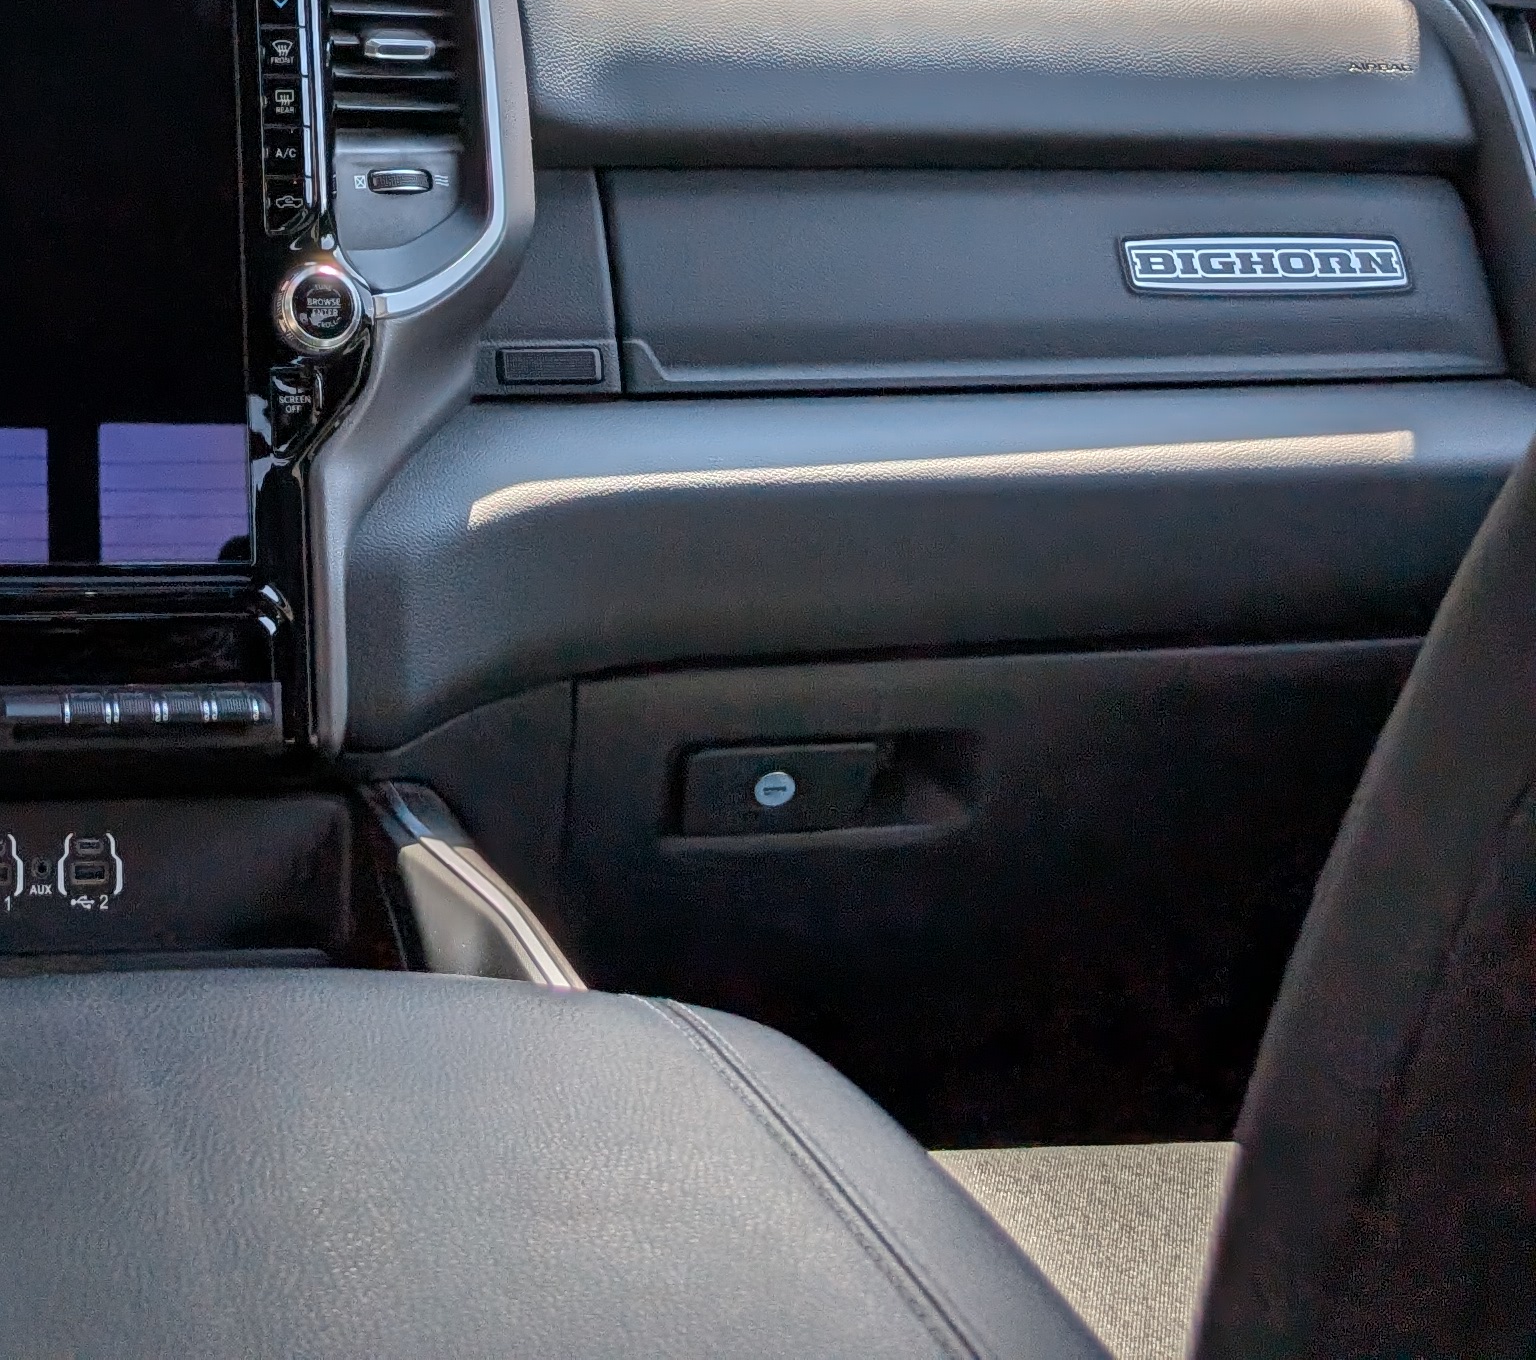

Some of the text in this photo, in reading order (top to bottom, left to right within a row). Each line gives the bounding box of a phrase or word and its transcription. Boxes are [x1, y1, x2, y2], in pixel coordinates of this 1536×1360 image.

[270, 56, 295, 64] FRONT
[1349, 61, 1414, 74] AIRBAG
[275, 106, 295, 114] REAR
[275, 147, 297, 158] A/C
[1130, 248, 1403, 279] BIGHORN
[306, 297, 342, 306] BROWSE
[312, 309, 339, 317] ENTER
[278, 395, 312, 404] SCREEN
[285, 405, 302, 414] OFF
[29, 884, 52, 895] AUX
[4, 895, 11, 911] 1
[99, 894, 109, 910] 2
